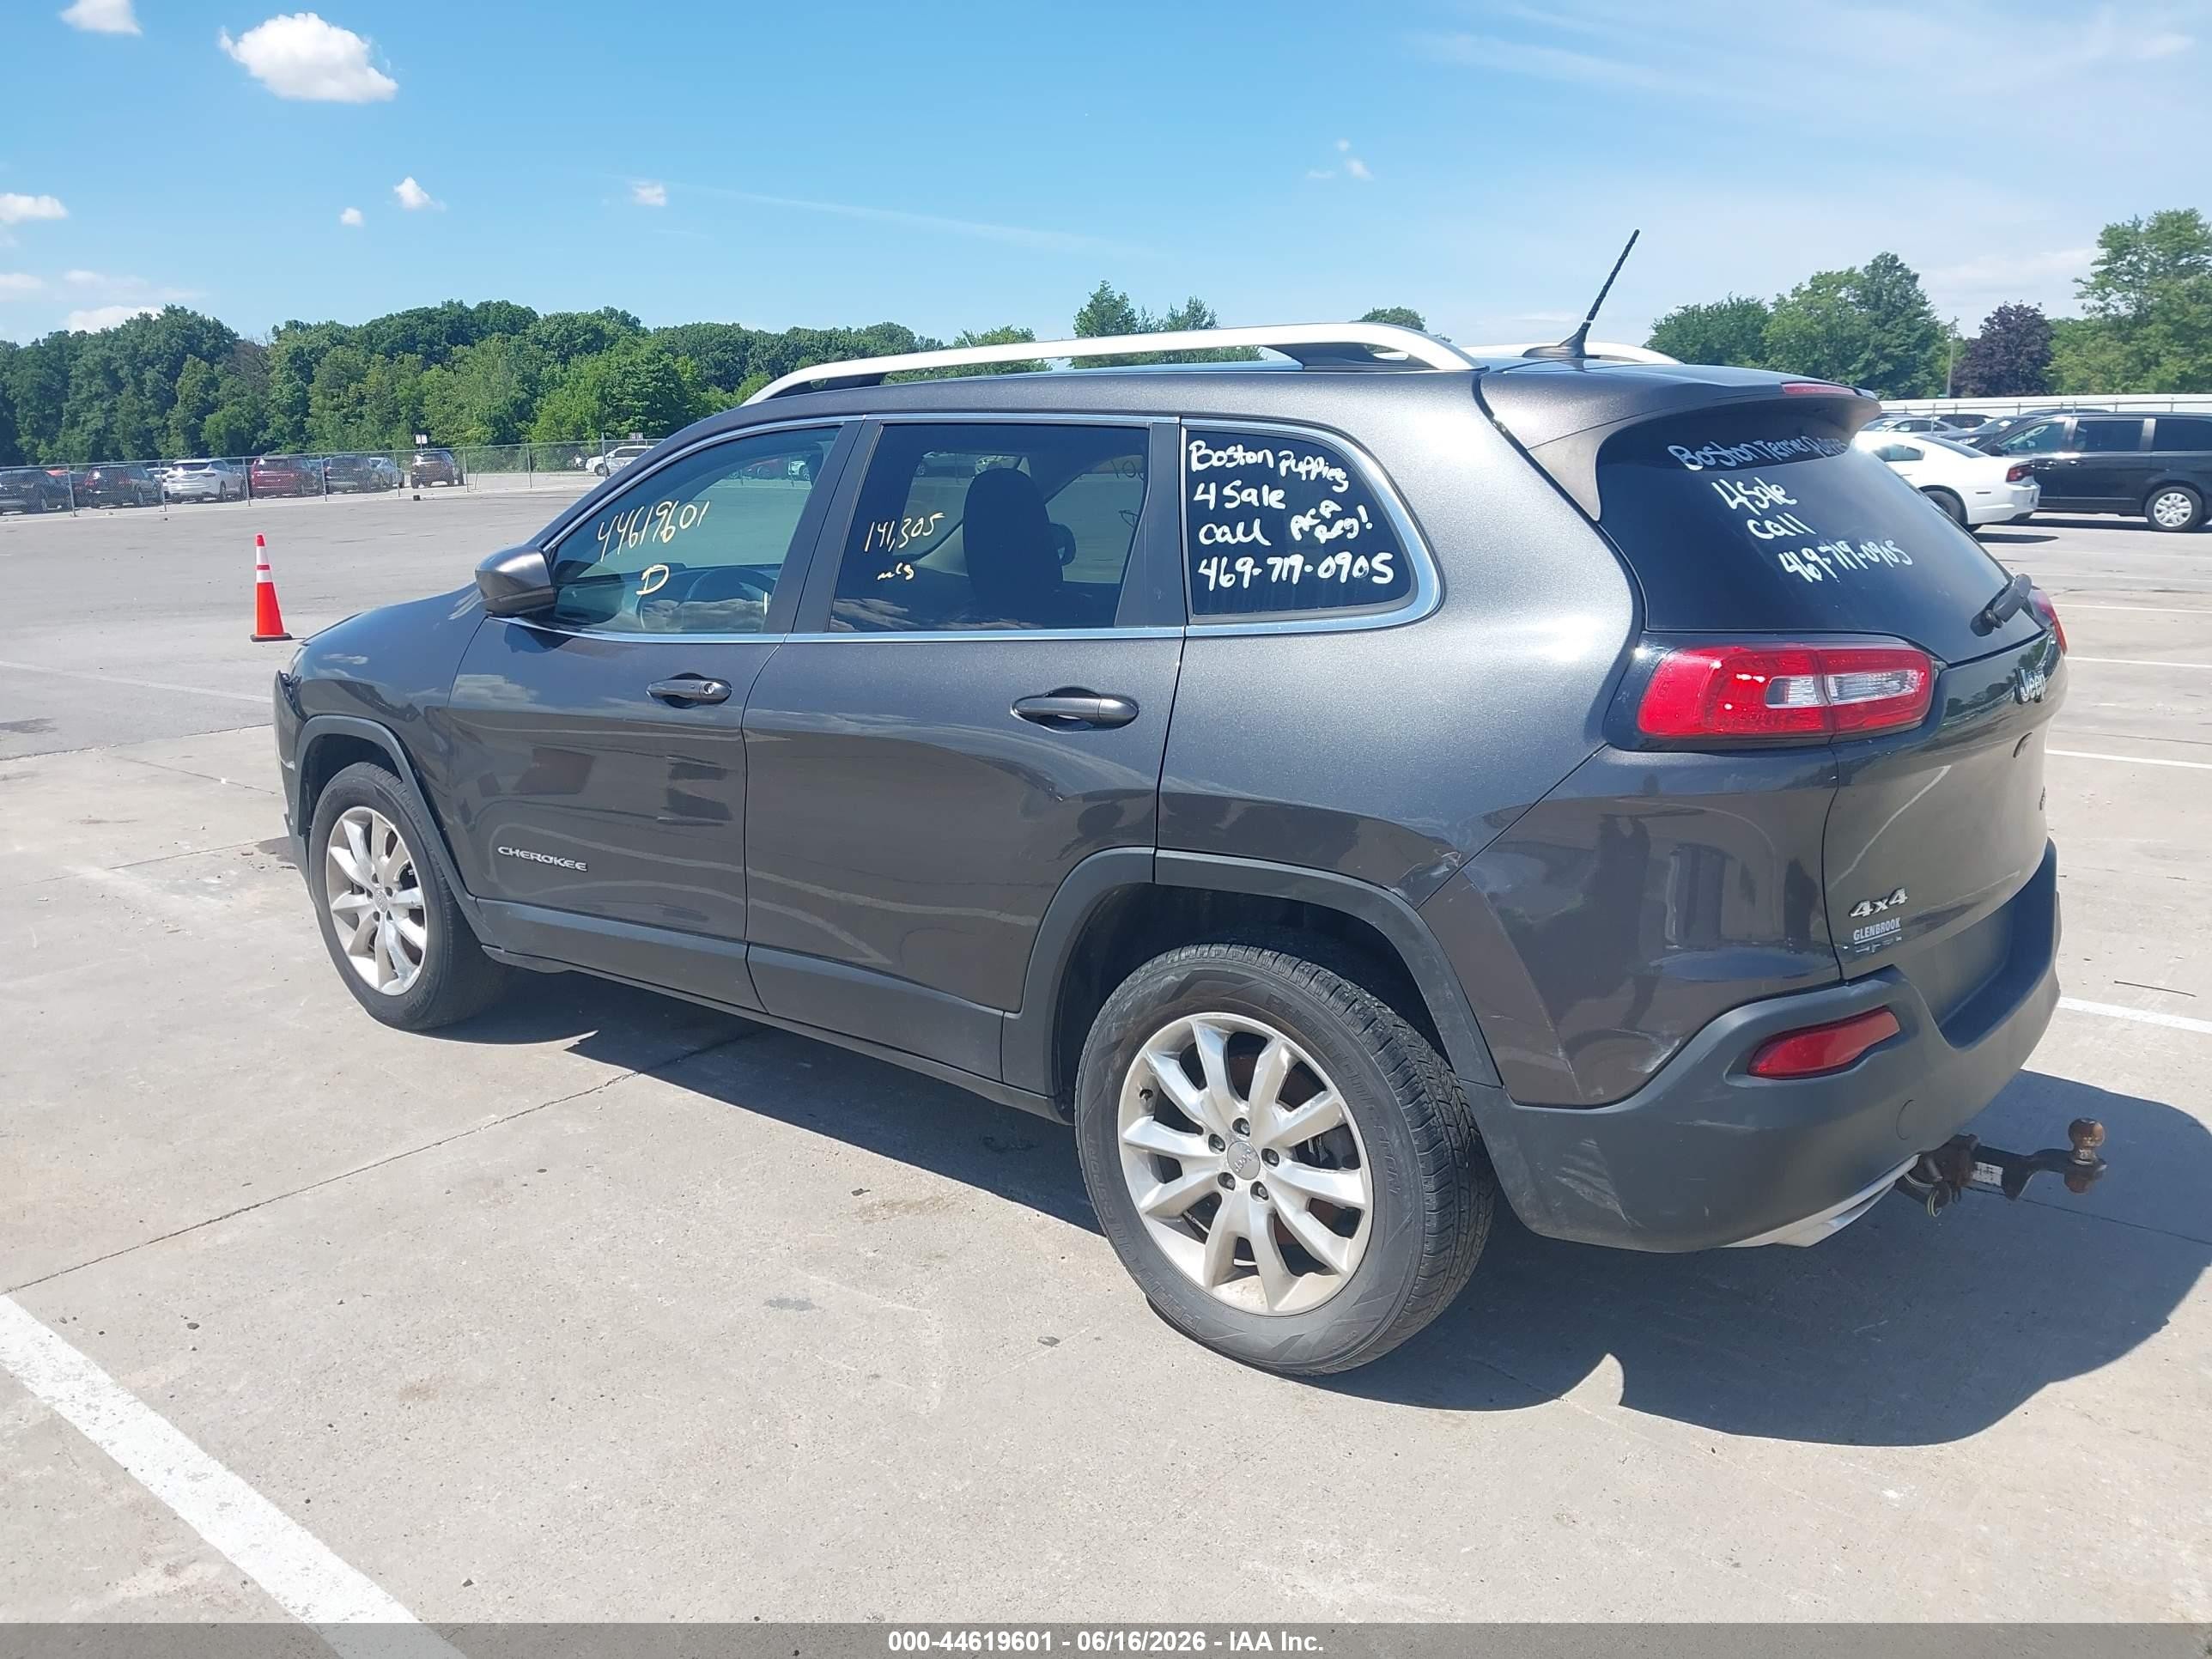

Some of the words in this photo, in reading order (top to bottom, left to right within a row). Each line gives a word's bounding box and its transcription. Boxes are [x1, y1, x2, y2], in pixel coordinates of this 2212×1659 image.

[1188, 440, 1274, 471] Boston
[1279, 450, 1349, 493] Puppies
[1668, 441, 1771, 471] Boston
[1194, 482, 1216, 510] 4
[1222, 479, 1285, 509] Sale
[598, 500, 710, 562] 44619601
[635, 564, 669, 595] D
[2016, 667, 2046, 703] Jeep
[497, 846, 588, 872] CHEROKEE
[1853, 916, 1902, 941] GLENBROOK
